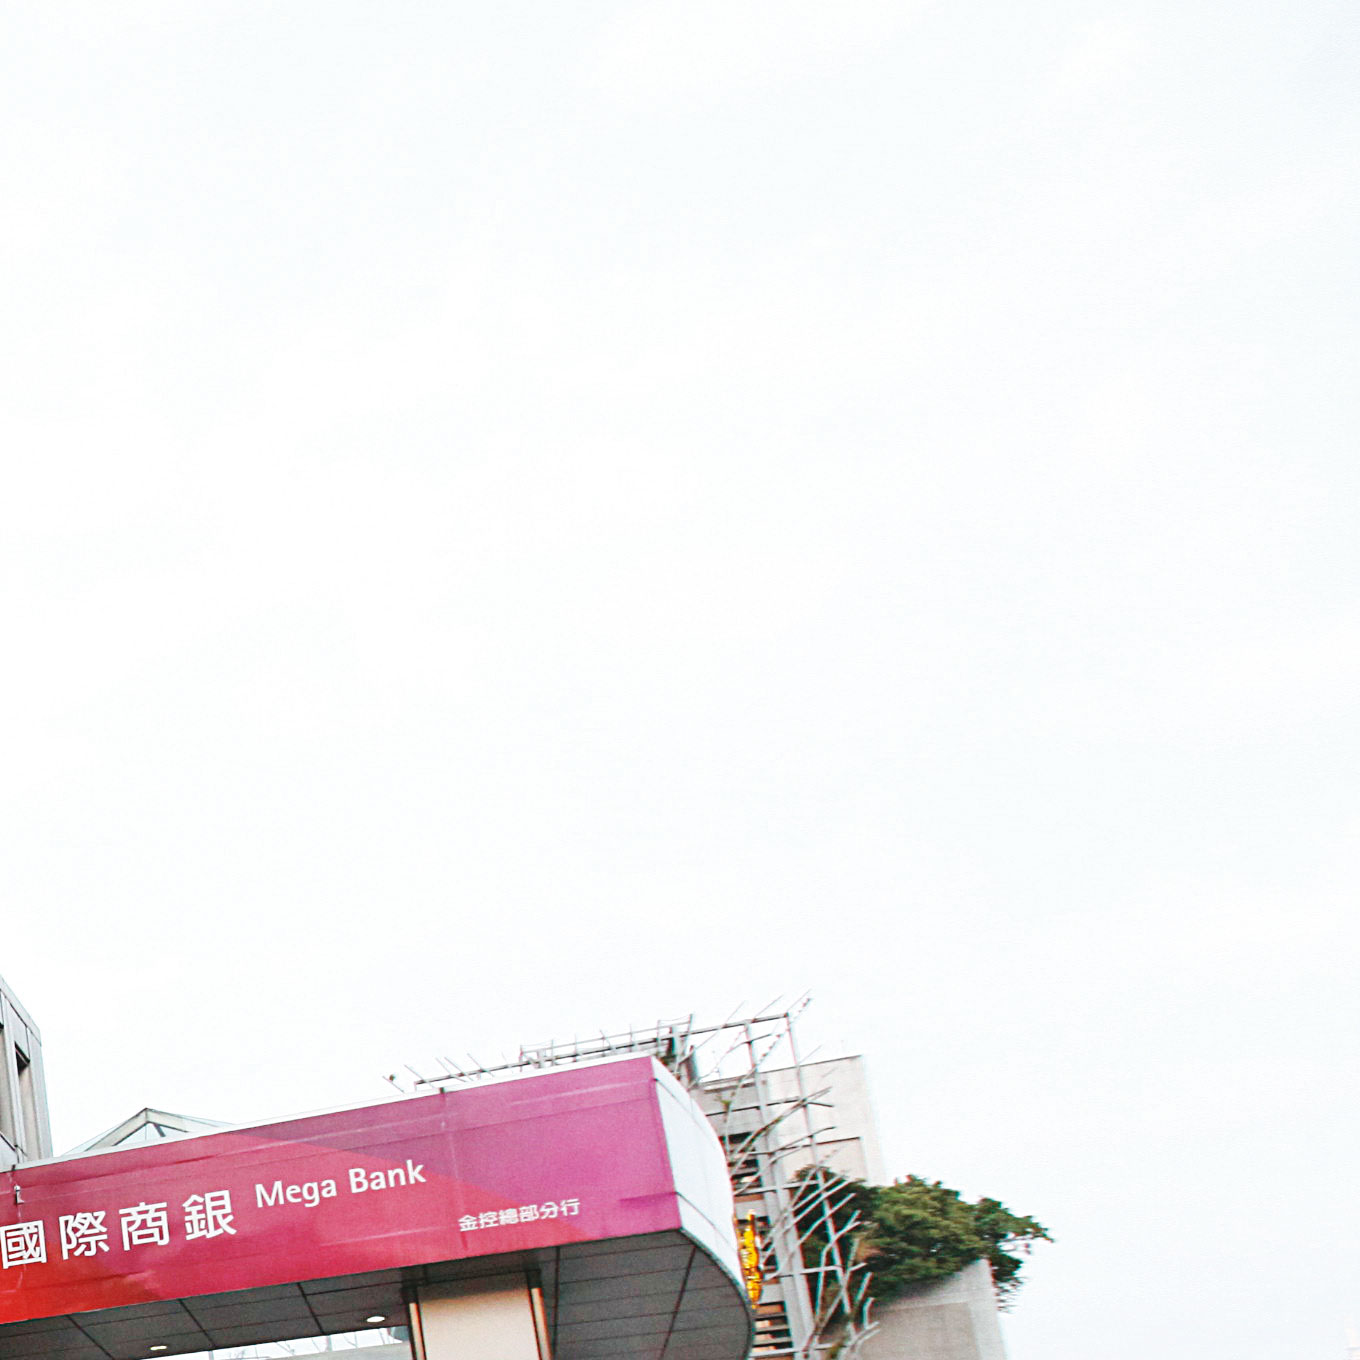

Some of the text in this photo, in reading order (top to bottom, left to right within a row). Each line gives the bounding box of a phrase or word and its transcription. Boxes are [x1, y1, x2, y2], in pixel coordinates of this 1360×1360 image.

[255, 1159, 427, 1208] Mega Bank
[458, 1198, 581, 1232] 金控總部分行
